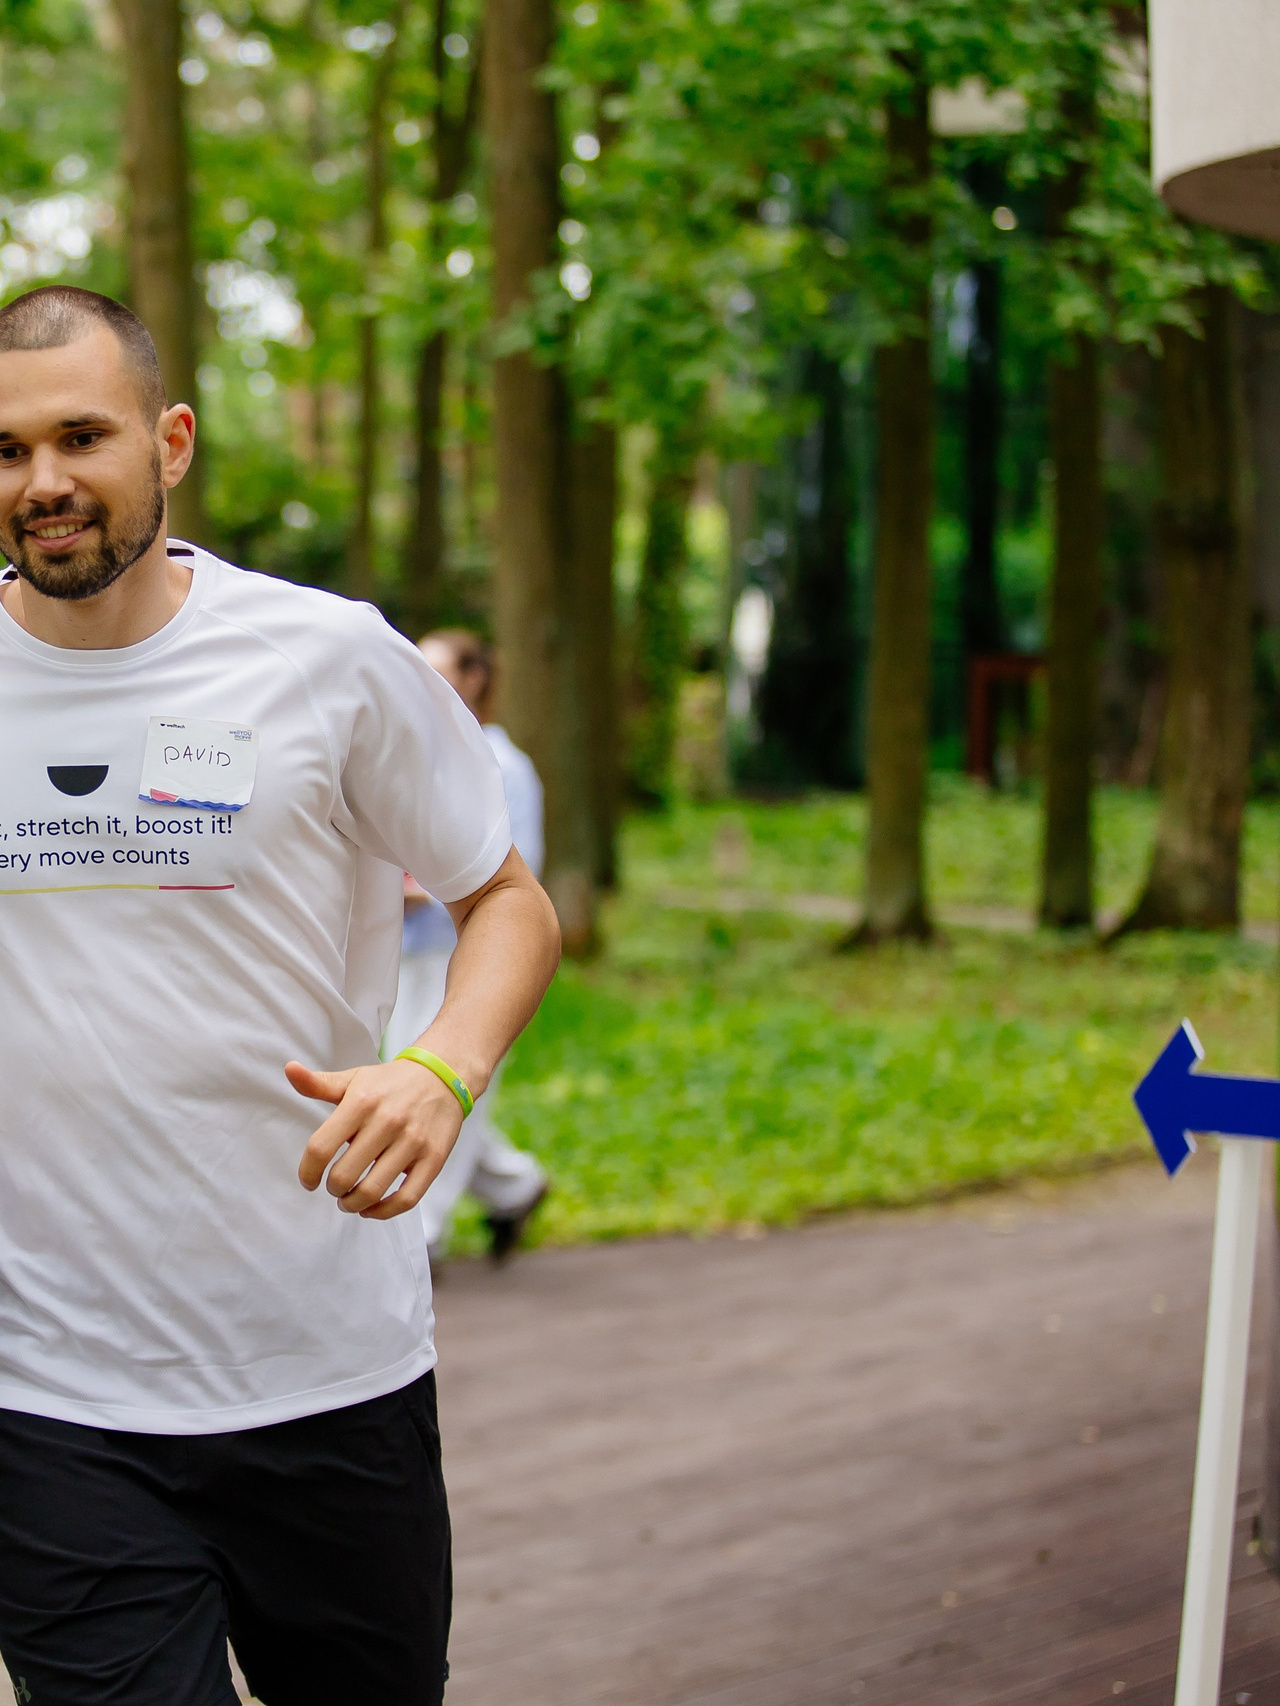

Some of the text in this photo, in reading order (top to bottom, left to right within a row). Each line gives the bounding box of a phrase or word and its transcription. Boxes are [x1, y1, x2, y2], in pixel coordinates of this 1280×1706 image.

[16, 815, 100, 837] stretch
[106, 815, 128, 838] it,
[136, 815, 204, 835] boost
[211, 814, 233, 834] it!
[39, 850, 105, 867] move
[112, 847, 190, 866] counts
